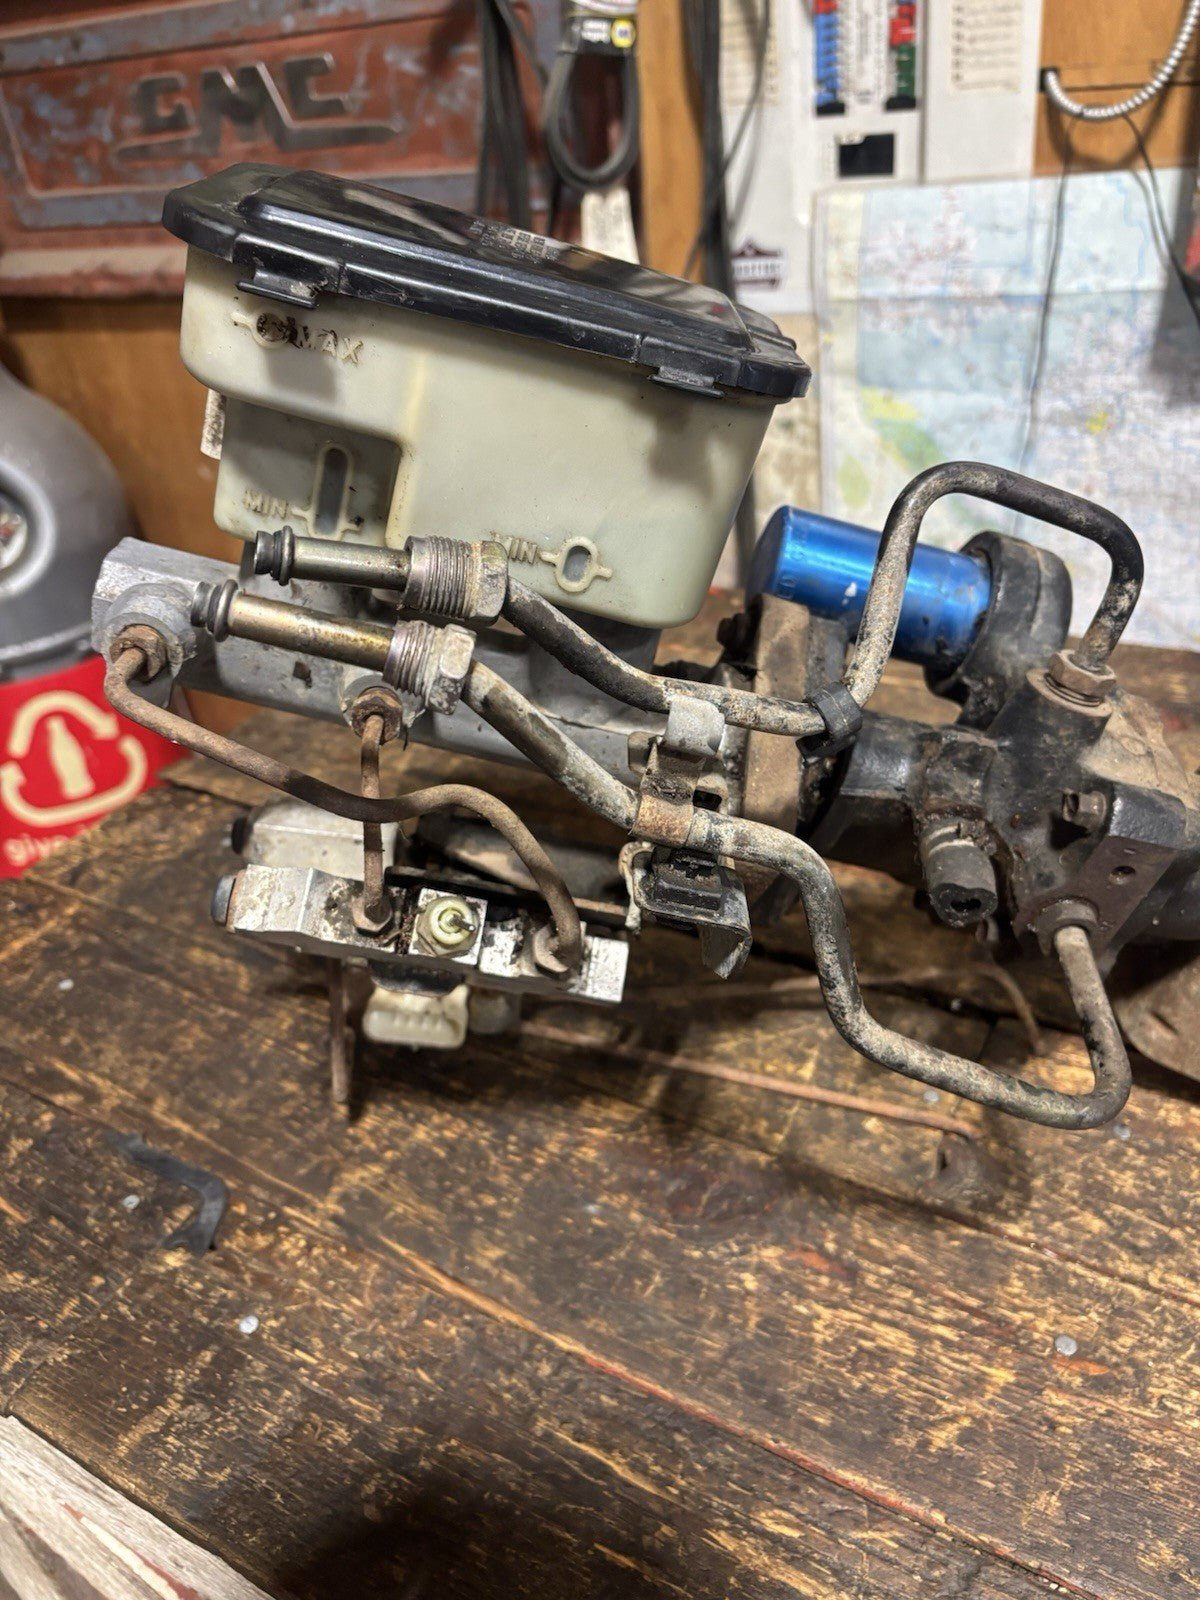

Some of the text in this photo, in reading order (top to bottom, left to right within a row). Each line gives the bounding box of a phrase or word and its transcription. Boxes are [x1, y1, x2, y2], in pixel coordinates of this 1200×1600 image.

[118, 51, 398, 153] GMC
[296, 323, 364, 366] MAX
[243, 488, 289, 519] MIN
